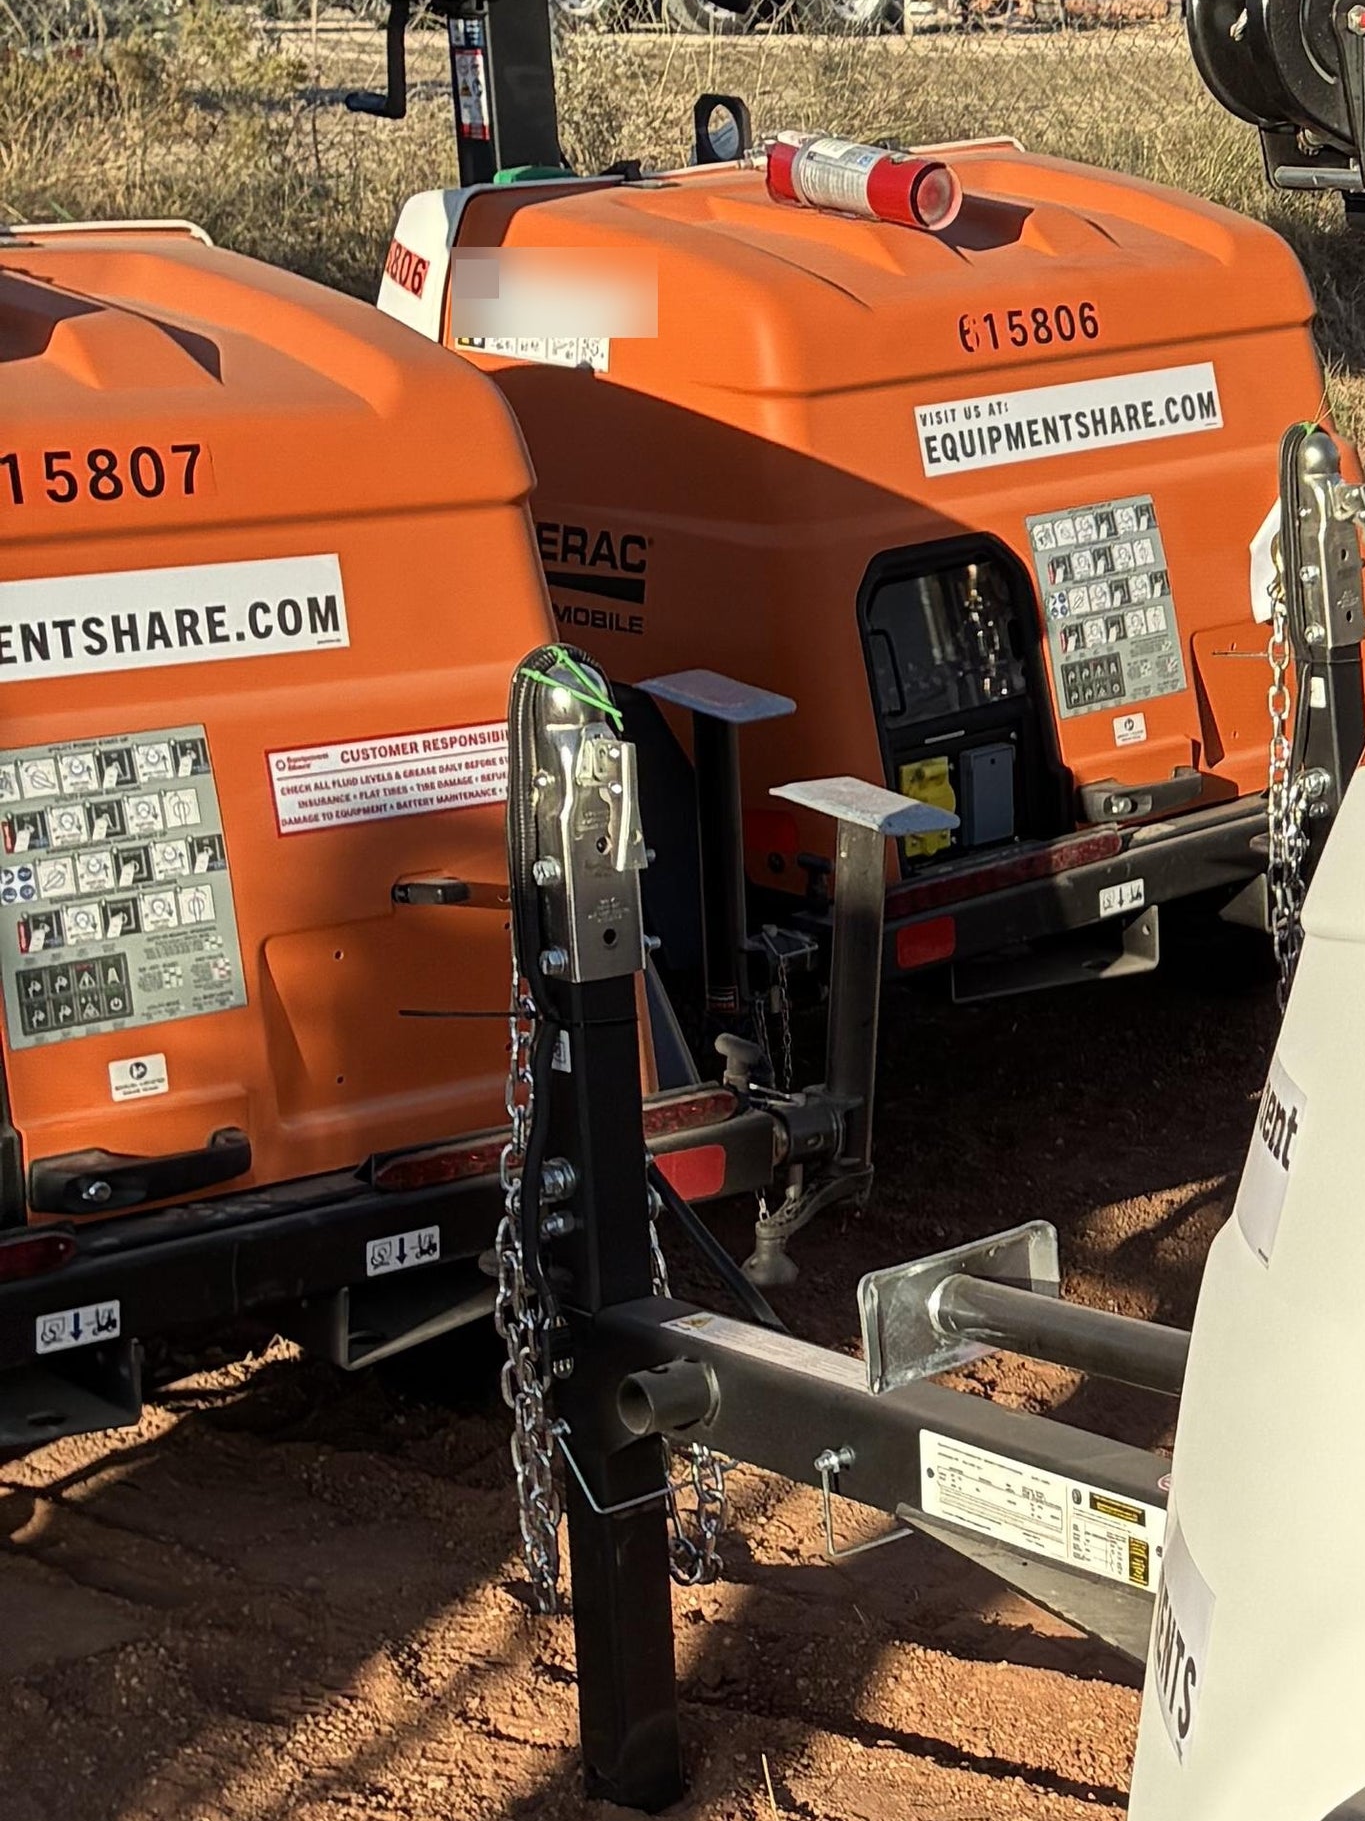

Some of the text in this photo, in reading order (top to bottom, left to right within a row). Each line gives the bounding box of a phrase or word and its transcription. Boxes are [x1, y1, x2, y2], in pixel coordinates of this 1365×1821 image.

[919, 401, 1009, 427] VISIT US AT:
[924, 390, 1218, 464] EQUIPMENTSHARE.COM
[553, 604, 644, 634] MOBILE
[340, 741, 419, 764] CUSTOMER
[298, 794, 351, 809] INSURANCE
[359, 790, 381, 800] FLAT
[416, 781, 436, 792] TIRE
[437, 776, 473, 790] DAMAGE
[314, 781, 330, 792] ALL
[282, 813, 320, 827] DAMAGE
[322, 811, 333, 822] TO
[335, 804, 388, 820] EQUIPMENT
[397, 797, 434, 811] BATTERY
